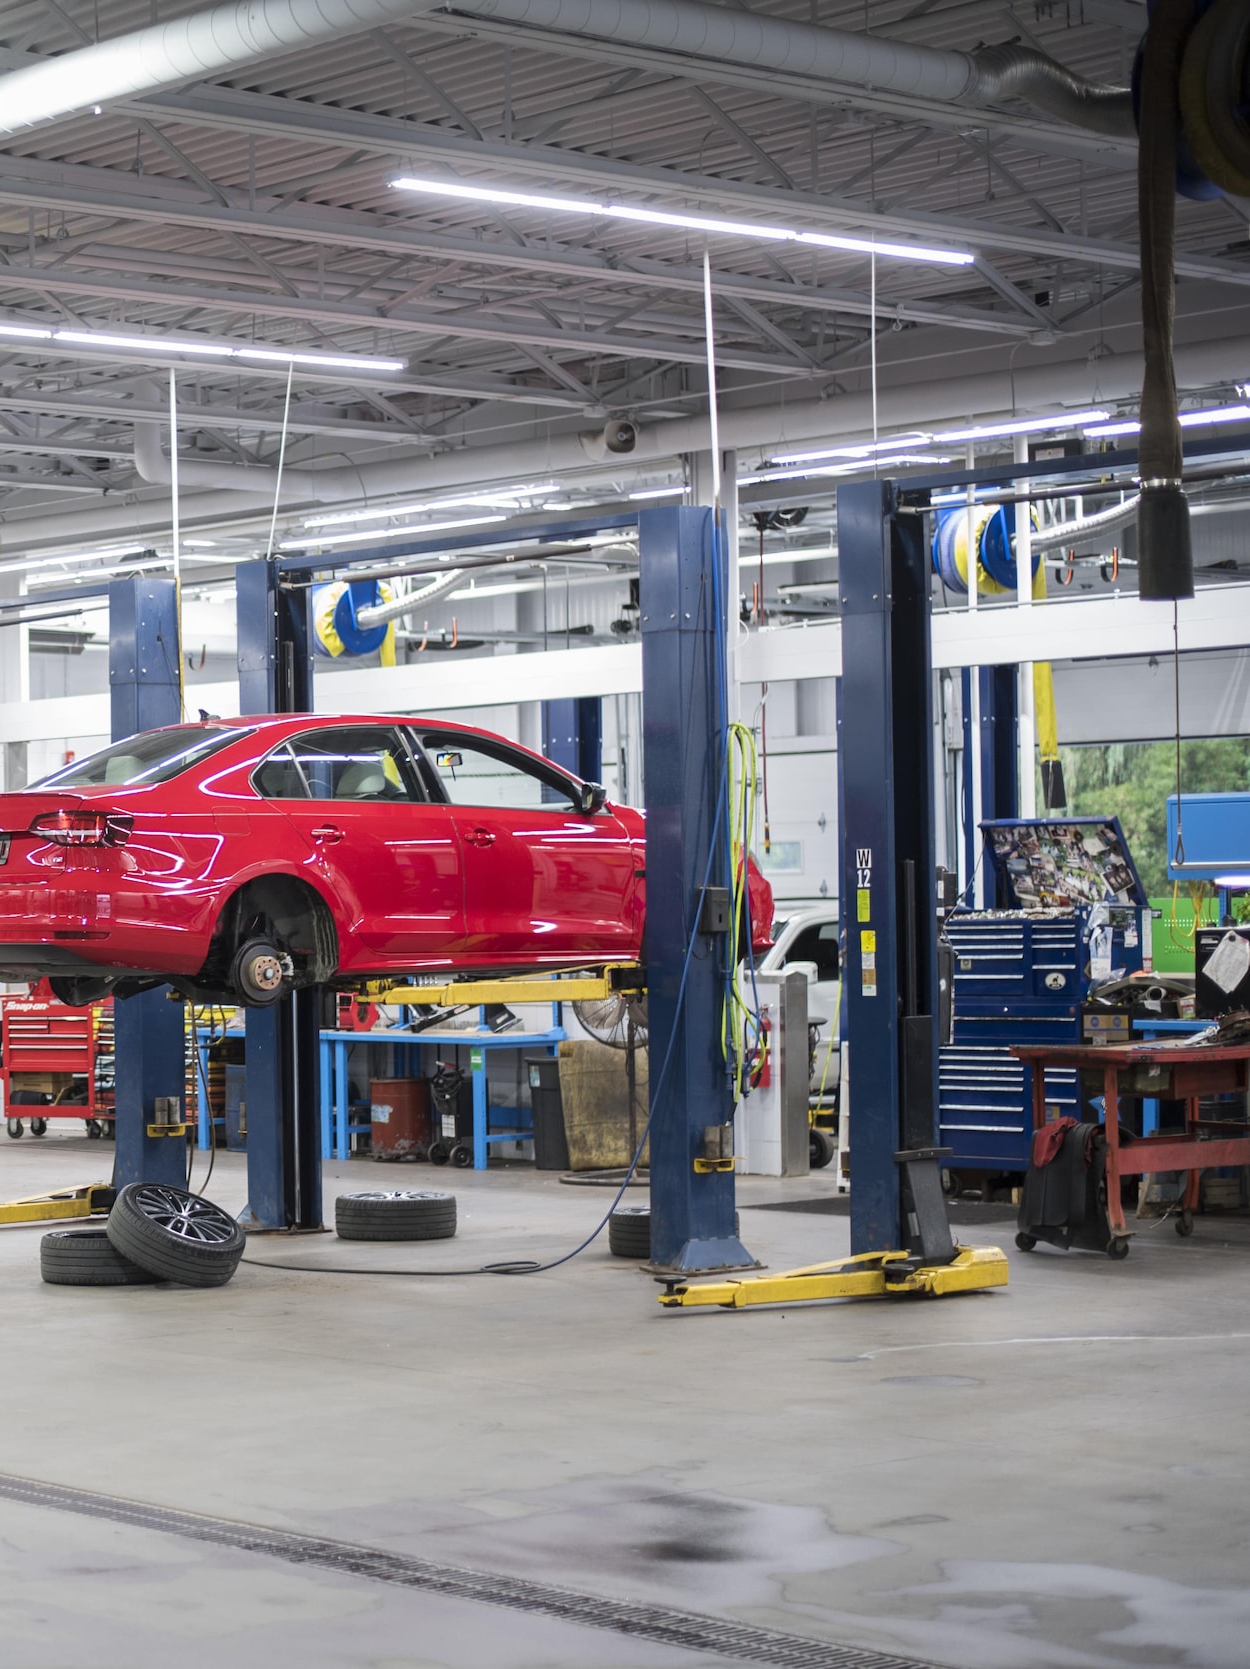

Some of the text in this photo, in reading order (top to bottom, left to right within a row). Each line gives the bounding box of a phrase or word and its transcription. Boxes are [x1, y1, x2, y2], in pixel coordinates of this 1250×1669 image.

[857, 849, 871, 868] W
[857, 869, 871, 888] 12
[4, 1001, 49, 1012] Snap-on
